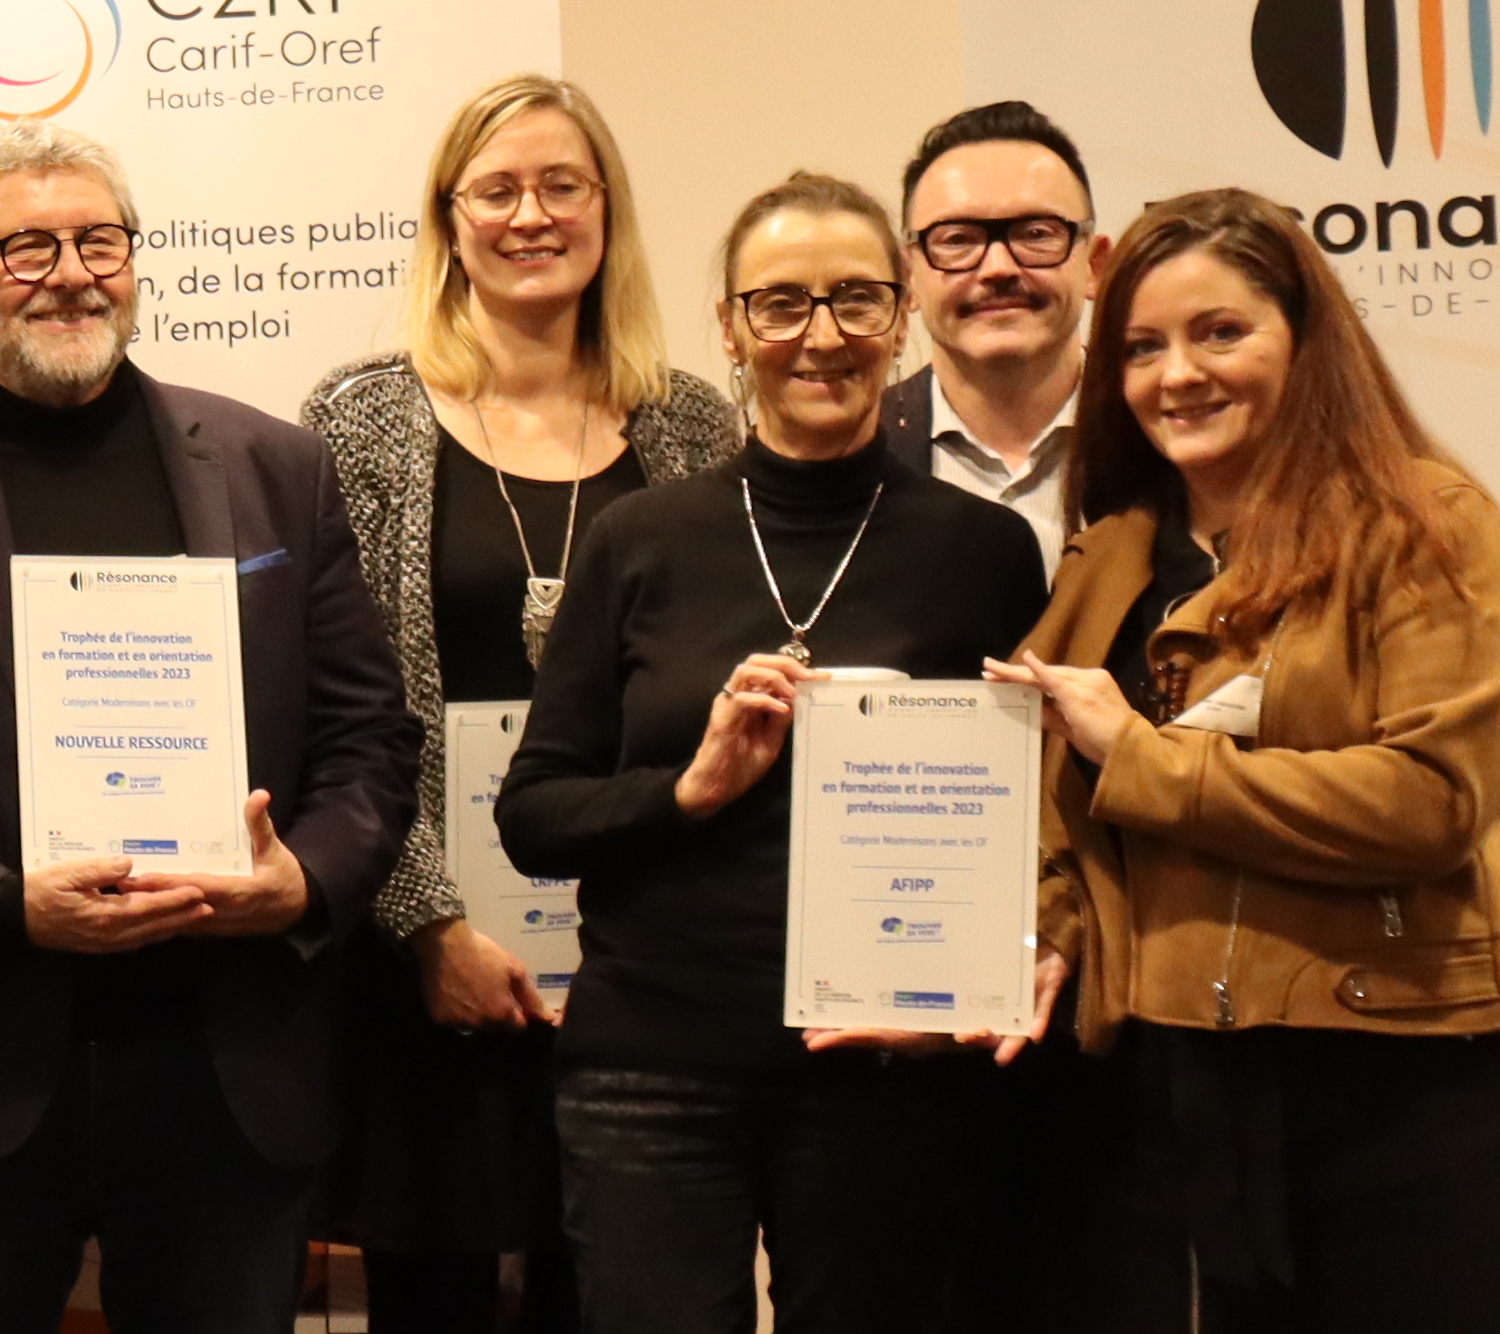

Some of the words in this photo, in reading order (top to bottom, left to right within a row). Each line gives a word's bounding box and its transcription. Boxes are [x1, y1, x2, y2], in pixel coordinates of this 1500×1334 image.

[146, 25, 383, 73] Carif-Oref
[147, 81, 385, 110] Hauts-de-France
[178, 265, 221, 295] de
[234, 264, 264, 292] la
[154, 309, 291, 348] l'emploi
[97, 572, 177, 583] Résonance
[60, 631, 106, 645] Trophée
[109, 632, 122, 643] de
[42, 651, 55, 659] en
[58, 648, 115, 660] formation
[117, 651, 129, 661] et
[132, 652, 146, 661] en
[149, 650, 212, 662] orientation
[65, 666, 158, 680] professionnelles
[162, 668, 190, 679] 2023
[55, 735, 125, 748] NOUVELLE
[128, 736, 208, 750] RESSOURCE
[890, 878, 934, 891] AFIPP
